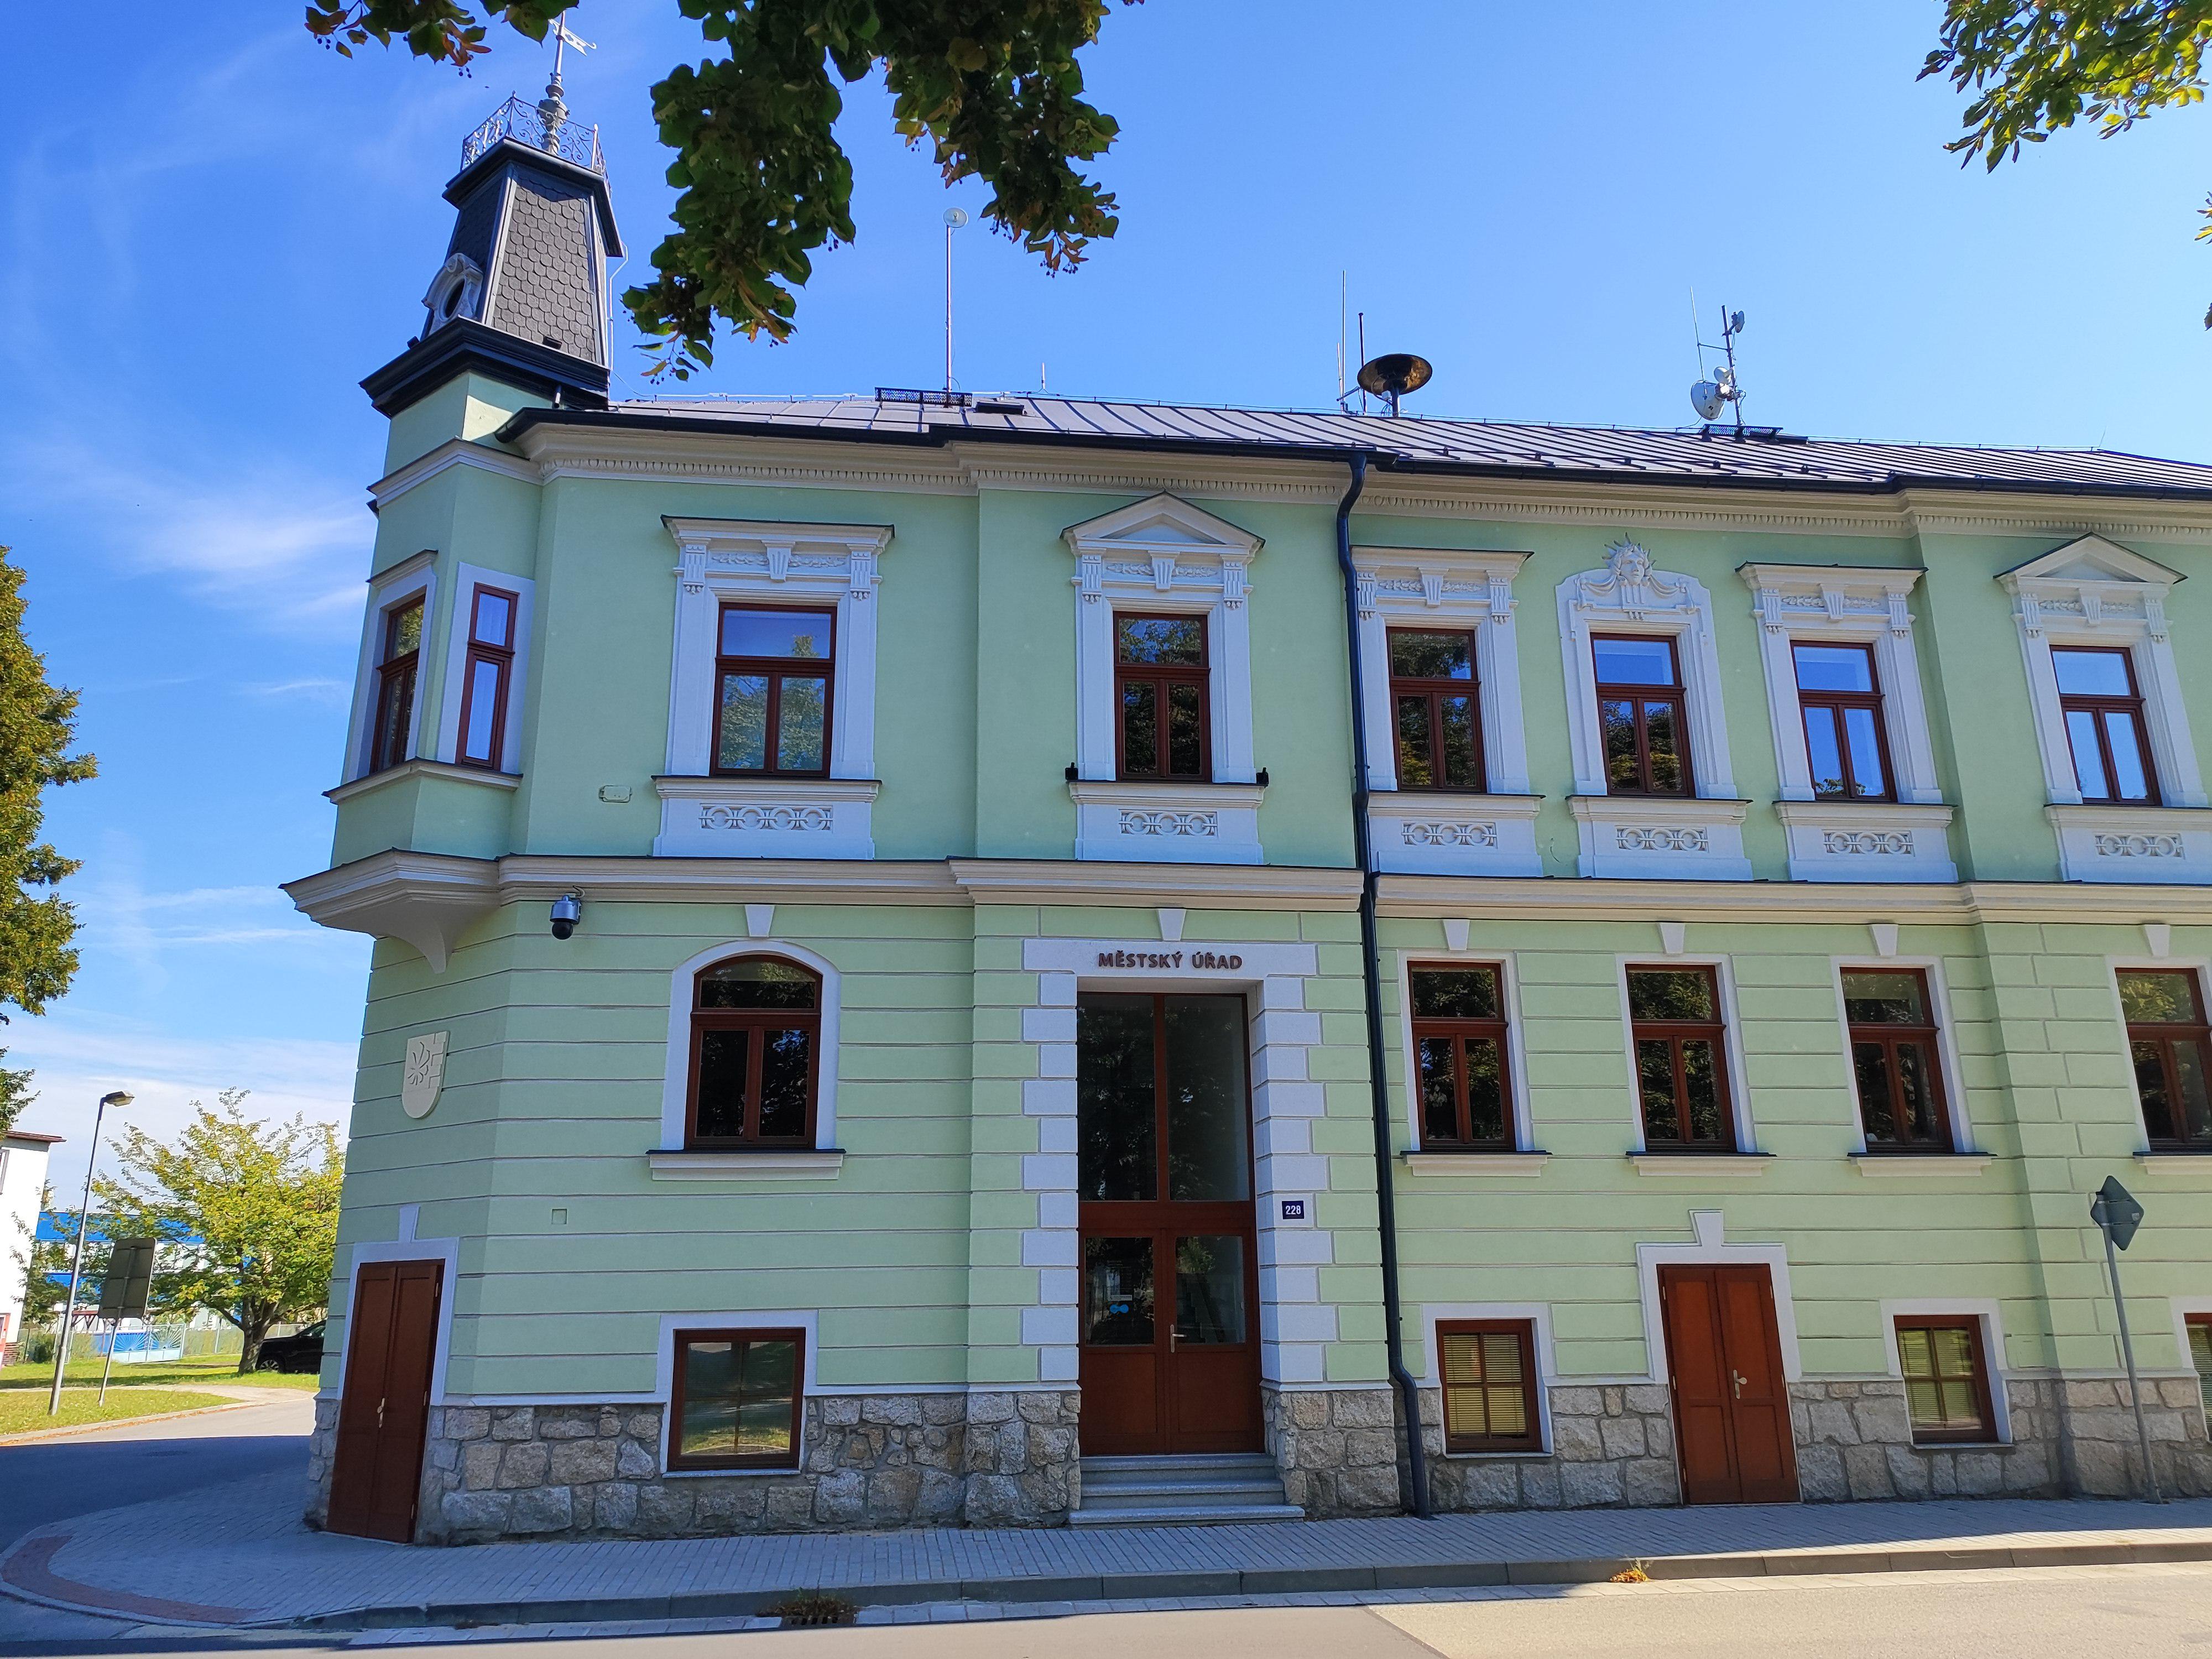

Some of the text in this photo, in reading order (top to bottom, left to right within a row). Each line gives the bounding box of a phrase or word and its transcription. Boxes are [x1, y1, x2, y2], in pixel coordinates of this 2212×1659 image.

[1098, 950, 1243, 969] MĚSTSKÝ ÚŘAD
[1286, 1205, 1301, 1214] 228
